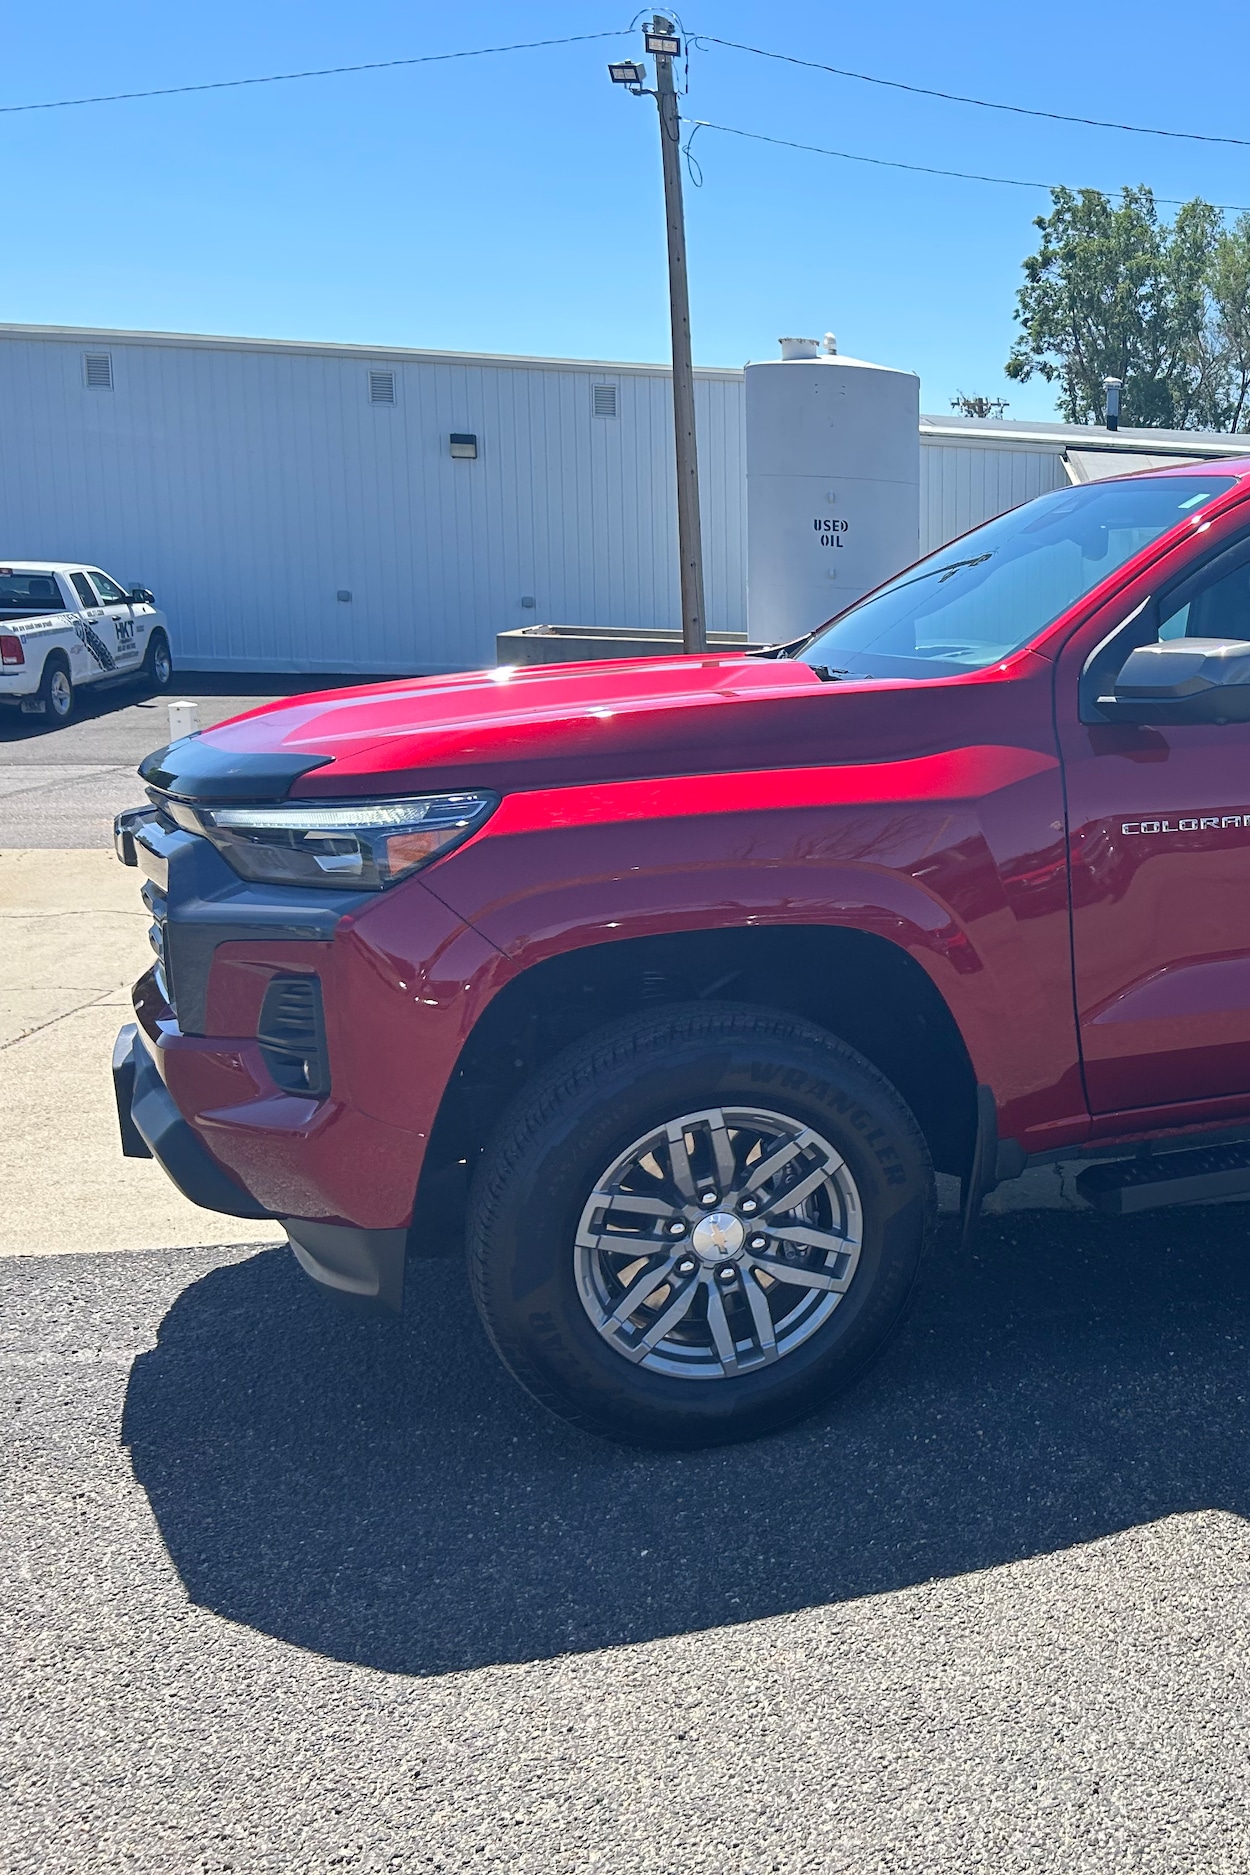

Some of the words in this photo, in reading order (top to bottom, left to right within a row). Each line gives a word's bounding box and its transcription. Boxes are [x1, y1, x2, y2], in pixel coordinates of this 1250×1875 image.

[813, 518, 849, 532] USED
[820, 534, 844, 548] OIL
[114, 620, 134, 640] HKT
[748, 1060, 907, 1187] WRANGLER
